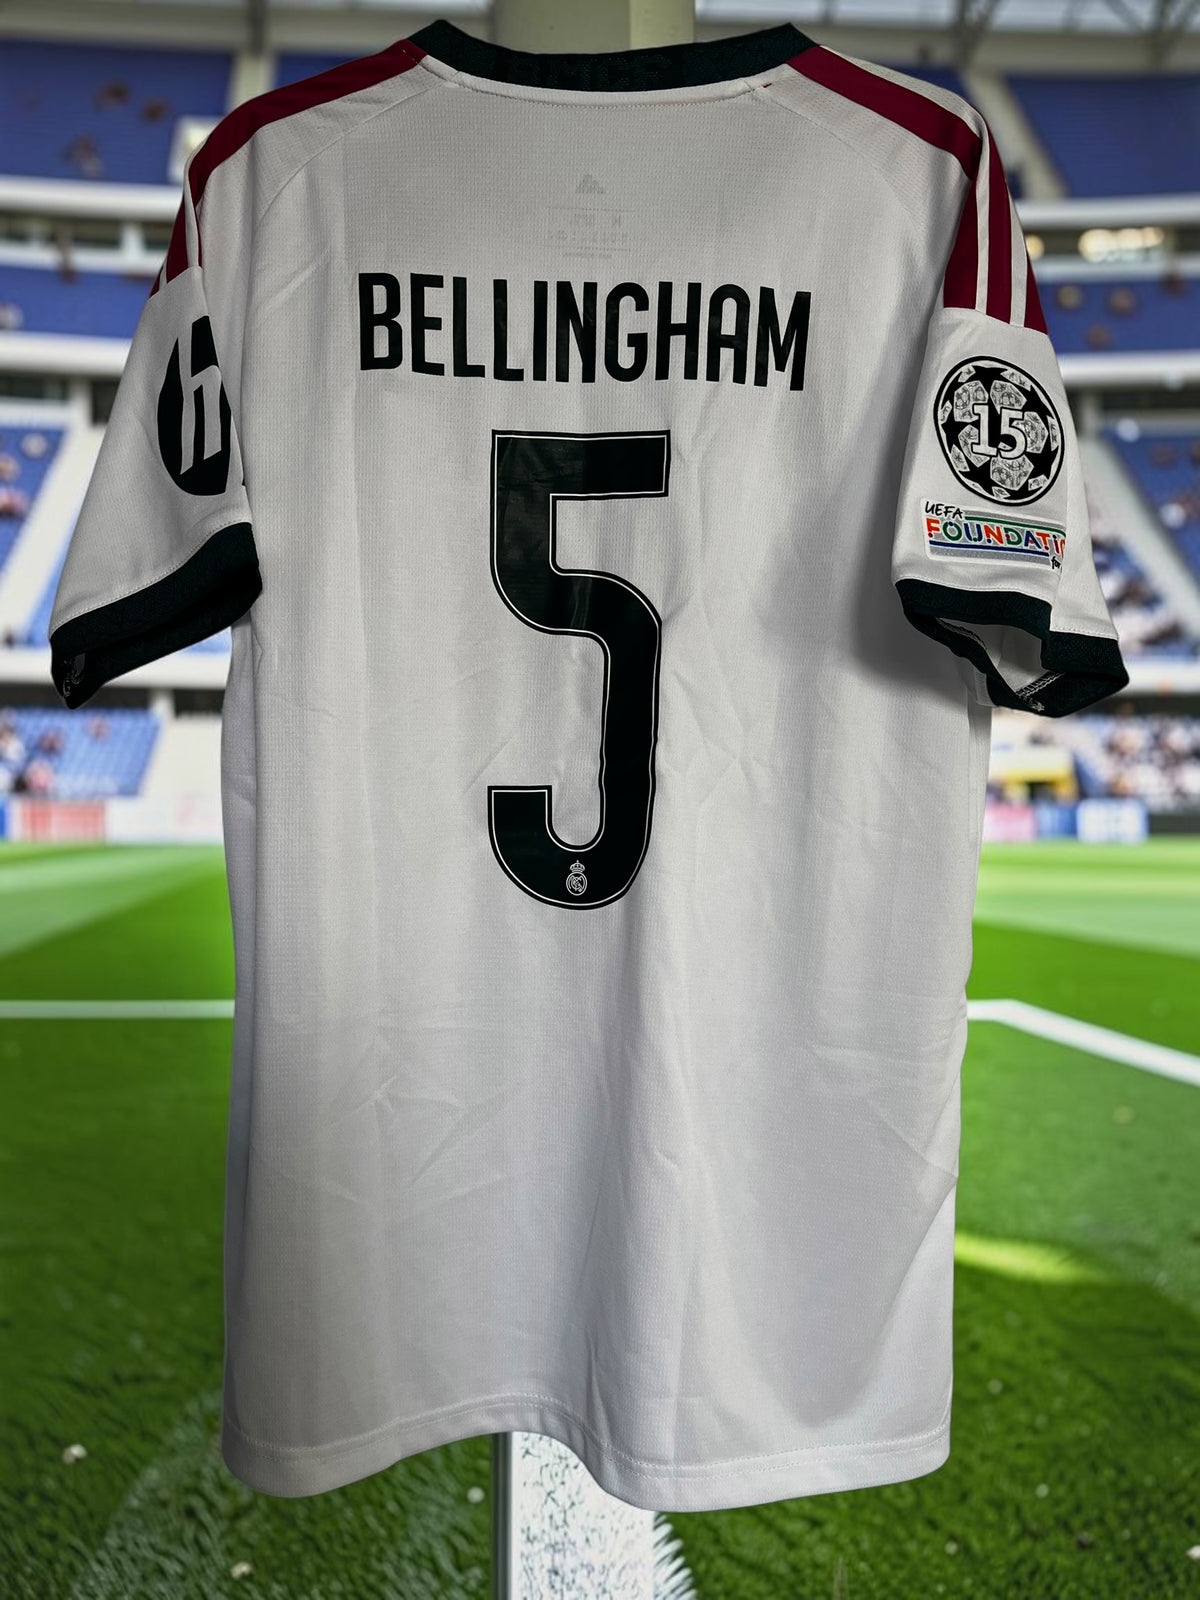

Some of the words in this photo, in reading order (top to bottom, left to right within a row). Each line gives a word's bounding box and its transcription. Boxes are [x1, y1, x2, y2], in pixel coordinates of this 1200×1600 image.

[358, 272, 812, 391] BELLINGHAM
[972, 404, 1028, 459] 15
[925, 501, 964, 519] UEFA
[487, 429, 671, 910] 5
